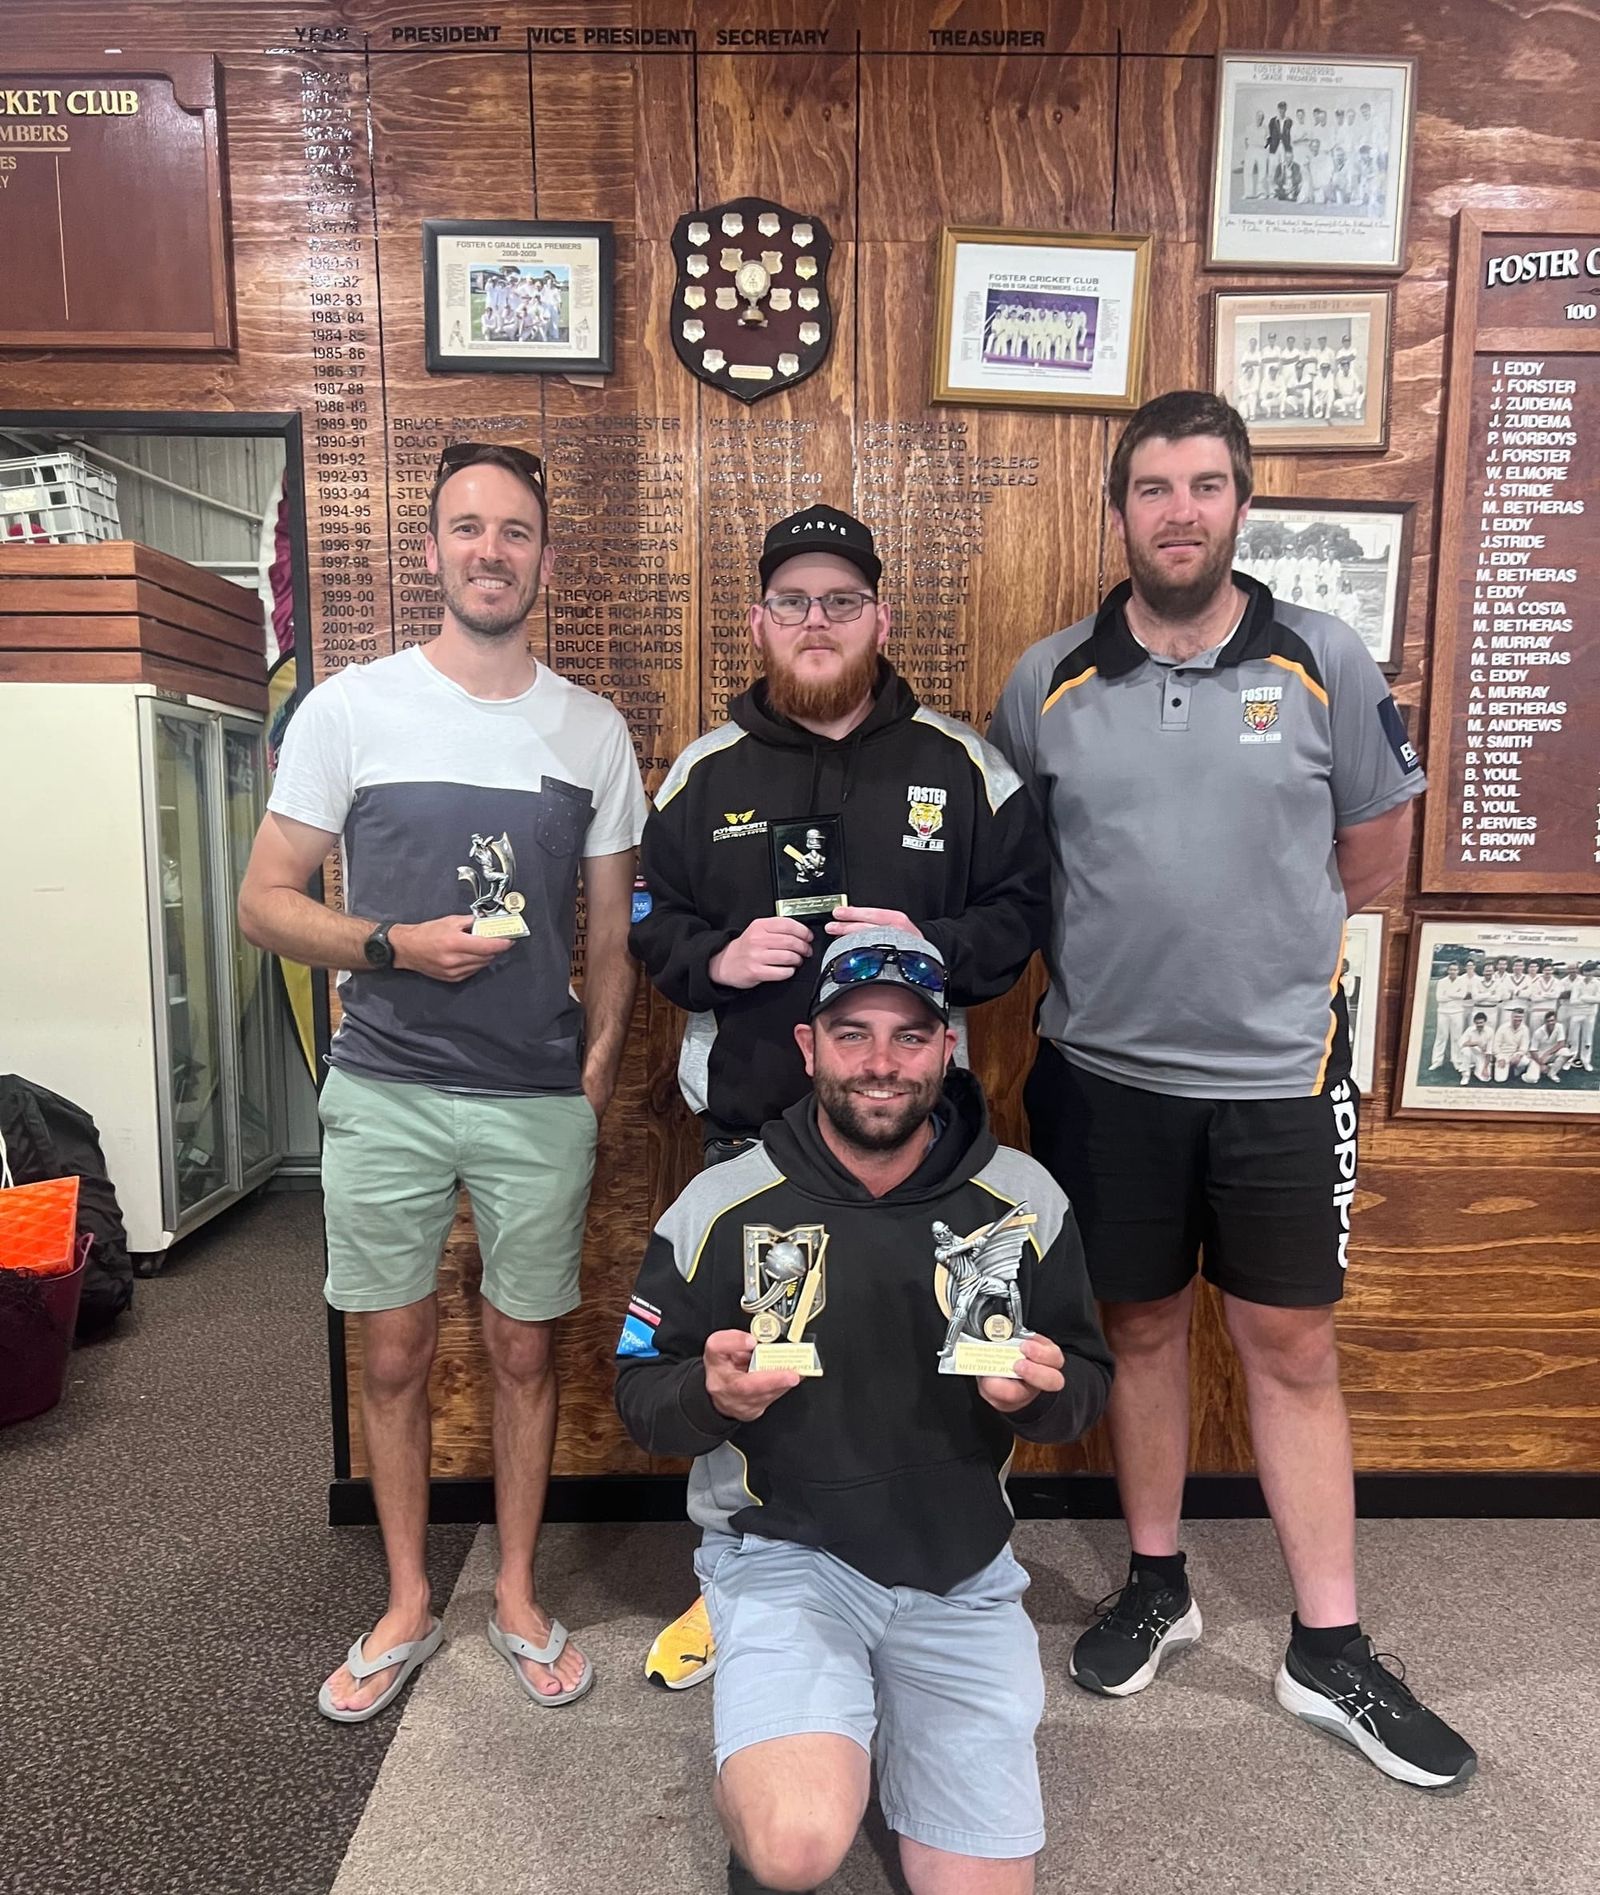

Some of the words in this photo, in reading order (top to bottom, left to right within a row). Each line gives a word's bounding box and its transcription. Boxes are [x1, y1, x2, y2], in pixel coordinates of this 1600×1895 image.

[295, 27, 349, 43] YEAR
[392, 26, 501, 43] PRESIDENT
[531, 27, 576, 44] VICE
[584, 27, 692, 45] PRESIDENT
[716, 29, 830, 46] SECRETARY
[928, 29, 1046, 47] TREASURER
[0, 90, 61, 115] KET
[66, 90, 139, 115] CLUB
[495, 241, 520, 249] GRADE
[544, 242, 582, 250] PREMIERS
[1486, 248, 1580, 287] FOSTER
[989, 273, 1027, 281] FOSTER
[1029, 275, 1071, 284] CRICKET
[1073, 277, 1099, 285] CLUB
[310, 293, 362, 306] 1982-83
[1564, 304, 1597, 319] 100
[313, 347, 366, 360] 1985-86
[1504, 361, 1545, 376] EDDY
[314, 383, 364, 395] 1987-88
[1491, 379, 1504, 392] J.
[1507, 379, 1577, 393] FORSTER
[1490, 397, 1503, 410] J.
[1505, 397, 1573, 411] ZUIDEMA
[315, 418, 368, 430] 1989-90
[393, 418, 444, 430] BRUCE
[1489, 414, 1501, 427] J.
[1504, 414, 1572, 428] ZUIDEMA
[316, 435, 366, 448] 1990-91
[394, 436, 437, 448] DOUG
[1487, 431, 1499, 445] P.
[1502, 431, 1577, 446] WORBOYS
[317, 453, 366, 465] 1991-92
[1486, 449, 1500, 462] J.
[1502, 449, 1571, 463] FORSTER
[317, 470, 368, 483] 1992-93
[1486, 466, 1502, 479] W.
[1505, 466, 1568, 480] ELMORE
[318, 487, 370, 500] 1993-94
[1484, 484, 1497, 497] J.
[1500, 484, 1554, 497] STRIDE
[318, 505, 371, 517] 1994-95
[397, 505, 431, 517] GEO
[1482, 501, 1500, 514] M.
[1503, 500, 1585, 515] BETHERAS
[319, 522, 371, 534] 1995-96
[791, 521, 848, 536] CARVE
[1493, 518, 1534, 531] EDDY
[320, 539, 371, 551] 1996-97
[320, 556, 369, 568] 1997-98
[1490, 552, 1531, 565] EDDY
[322, 573, 373, 585] 1998-99
[618, 573, 691, 585] ANDREWS
[1476, 569, 1494, 582] M.
[1496, 568, 1577, 583] BETHERAS
[322, 590, 374, 602] 1999-00
[557, 590, 612, 602] TREVOR
[618, 590, 690, 602] ANDREWS
[1486, 585, 1528, 599] EDDY
[322, 605, 375, 617] 2000-01
[555, 607, 603, 619] BRUCE
[609, 607, 683, 619] RICHARDS
[711, 609, 749, 621] TONY
[1473, 602, 1491, 615] M.
[1494, 602, 1515, 615] DA
[1518, 602, 1567, 615] COSTA
[322, 622, 375, 634] 2001-02
[555, 624, 604, 636] BRUCE
[609, 624, 683, 636] RICHARDS
[711, 626, 748, 638] TONY
[1473, 619, 1491, 632] M.
[1493, 619, 1574, 633] BETHERAS
[323, 639, 377, 651] 2002-03
[555, 641, 604, 653] BRUCE
[609, 641, 683, 653] RICHARDS
[711, 642, 750, 654] TONY
[1472, 636, 1488, 649] A.
[1491, 636, 1554, 649] MURRAY
[912, 644, 968, 656] WRIGHT
[556, 657, 604, 669] BRUCE
[609, 657, 683, 670] RICHARDS
[711, 659, 749, 671] TONY
[1471, 653, 1489, 666] M.
[1491, 652, 1572, 666] BETHERAS
[911, 660, 968, 672] WRIGHT
[601, 675, 650, 686] COLLIS
[711, 676, 749, 688] TONY
[1470, 669, 1487, 682] G.
[1489, 669, 1530, 682] EDDY
[916, 677, 952, 689] TODD
[1241, 686, 1282, 703] FOSTER
[1469, 686, 1486, 699] A.
[1488, 686, 1551, 699] MURRAY
[1468, 702, 1487, 715] M.
[1488, 702, 1568, 715] BETHERAS
[1467, 719, 1485, 732] M.
[1487, 719, 1563, 732] ANDREWS
[1467, 735, 1484, 748] W.
[1486, 735, 1533, 748] SMITH
[1465, 752, 1481, 765] B.
[1483, 752, 1522, 765] YOUL
[1464, 768, 1480, 781] B.
[1483, 768, 1522, 781] YOUL
[907, 785, 947, 806] FOSTER
[1463, 784, 1479, 797] B.
[1481, 784, 1521, 797] YOUL
[1463, 801, 1479, 814] B.
[1481, 801, 1520, 814] YOUL
[1462, 817, 1473, 830] P.
[1476, 816, 1538, 830] JERVIES
[1461, 833, 1477, 846] K.
[1480, 833, 1536, 846] BROWN
[1461, 849, 1477, 862] A.
[1479, 849, 1522, 862] RACK
